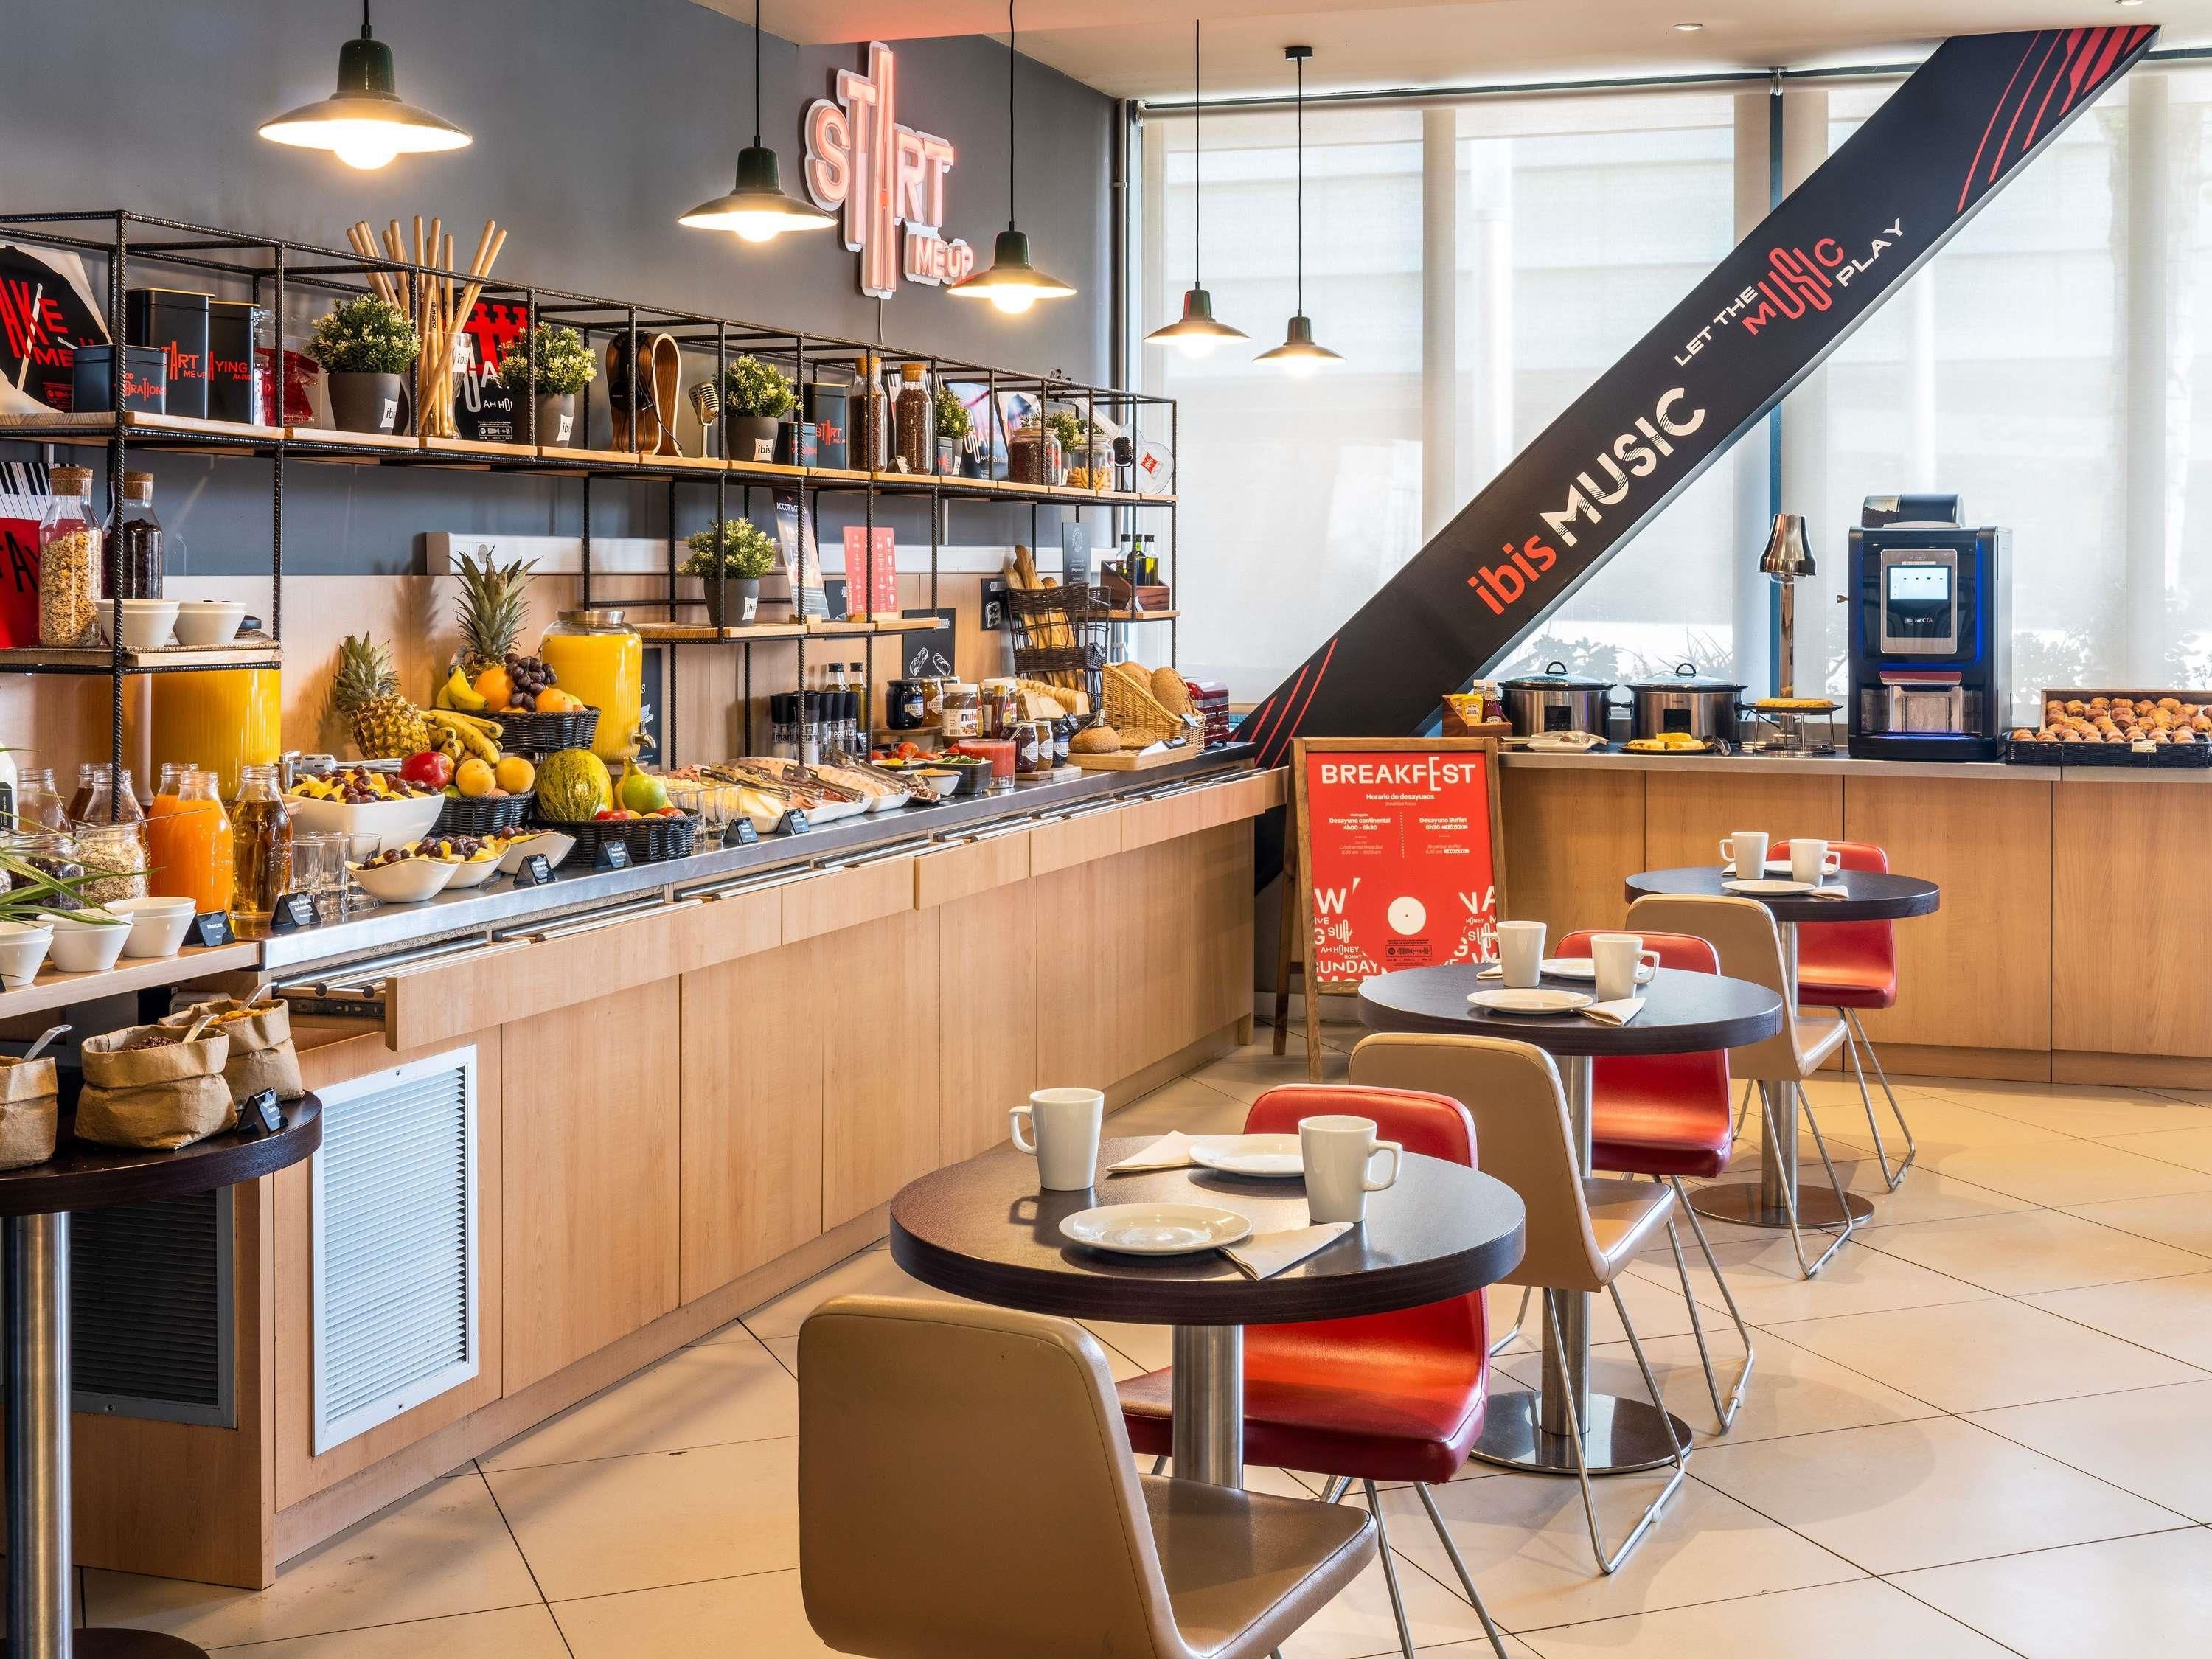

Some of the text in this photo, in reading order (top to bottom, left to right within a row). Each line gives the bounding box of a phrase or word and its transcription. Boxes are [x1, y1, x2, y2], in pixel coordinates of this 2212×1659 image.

[811, 44, 955, 293] START
[914, 233, 973, 279] ME UP
[1834, 217, 1904, 288] PLAY
[1742, 237, 1844, 335] MUSIC
[1674, 285, 1759, 366] LET THE
[161, 341, 200, 381] TART
[758, 445, 771, 454] ibis
[1467, 387, 1705, 616] ibis MUSIC
[1321, 756, 1475, 791] BREAKFEST
[1399, 793, 1435, 801] desayunos
[1466, 917, 1484, 925] HONEY
[1333, 945, 1360, 956] HONEY
